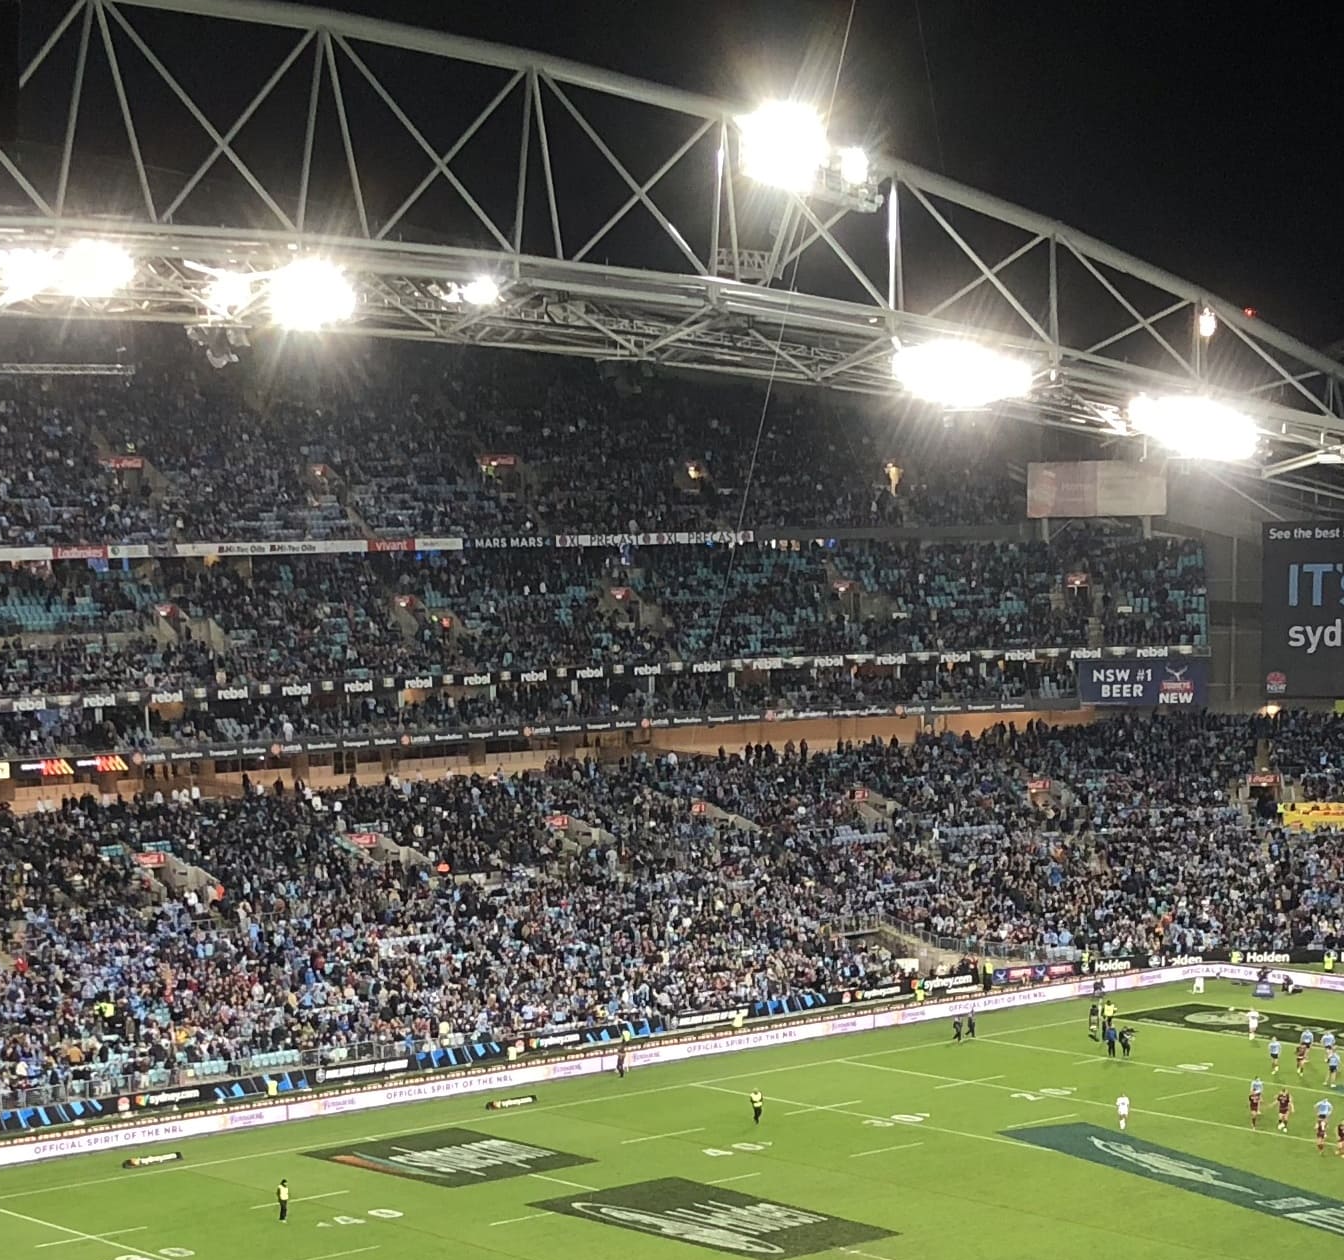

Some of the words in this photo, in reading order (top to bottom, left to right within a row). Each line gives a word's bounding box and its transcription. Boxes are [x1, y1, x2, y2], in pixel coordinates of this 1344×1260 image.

[590, 535, 640, 546] PRECAST
[1268, 528, 1290, 540] See
[1294, 528, 1312, 539] the
[1315, 527, 1340, 539] best
[475, 538, 507, 548] MARS
[510, 537, 544, 548] MARS
[58, 548, 103, 558] Ladbrokes
[814, 654, 844, 668] rebel
[876, 653, 906, 666] rebel
[1004, 649, 1036, 662] rebel
[1070, 648, 1102, 660] rebel
[634, 663, 662, 676] rebel
[692, 660, 721, 674] rebel
[463, 672, 491, 686] rebel
[520, 669, 548, 682] rebel
[1092, 668, 1130, 682] NSW
[1136, 668, 1152, 682] #1
[282, 682, 312, 697] rebel
[344, 678, 374, 693] rebel
[1101, 684, 1144, 698] BEER
[83, 693, 116, 708] rebel
[152, 688, 184, 704] rebel
[1158, 692, 1194, 704] NEW
[1247, 952, 1290, 964] Holden
[1094, 959, 1130, 972] Holden
[924, 974, 972, 992] sydney.com
[386, 1088, 428, 1100] OFFICIAL
[431, 1080, 460, 1092] SPIRIT
[478, 1076, 494, 1087] THE
[497, 1074, 512, 1084] NRL
[150, 1088, 201, 1104] sydney.com
[34, 1141, 84, 1155] OFFICIAL
[87, 1132, 120, 1148] SPIRIT
[140, 1128, 160, 1138] THE
[164, 1124, 184, 1134] NRL
[388, 1138, 557, 1176] sydney.com
[666, 1200, 829, 1235] Holden
